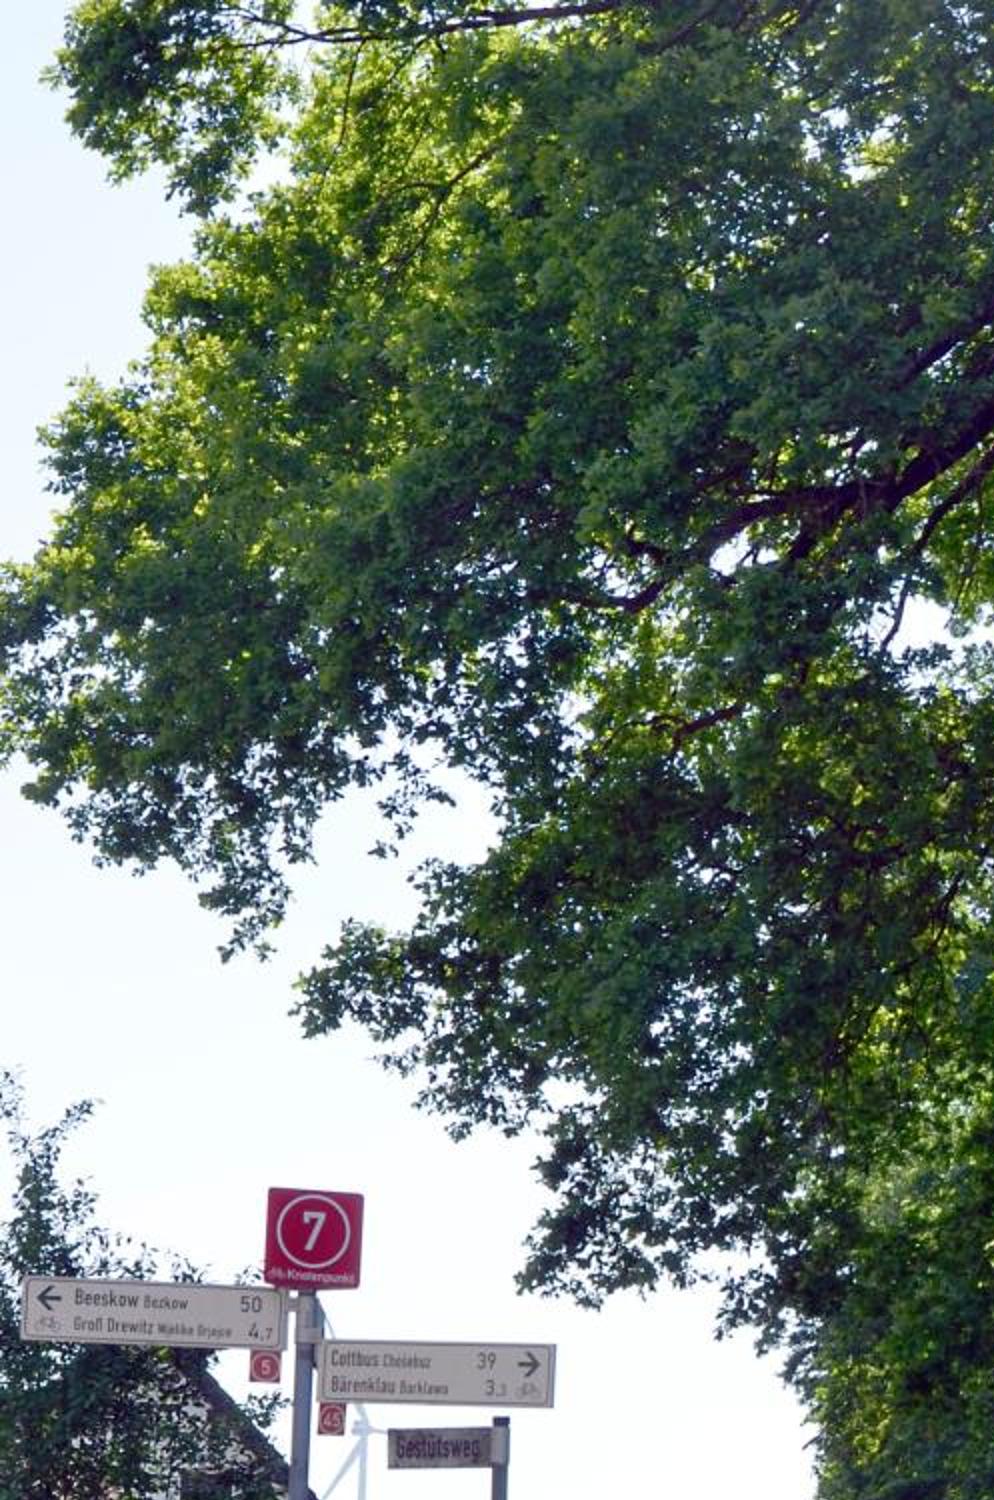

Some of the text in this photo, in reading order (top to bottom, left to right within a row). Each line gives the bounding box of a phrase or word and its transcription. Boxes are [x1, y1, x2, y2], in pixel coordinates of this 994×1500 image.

[303, 1210, 326, 1251] 7
[75, 1288, 139, 1309] Beeskow
[240, 1295, 263, 1313] 50
[107, 1318, 154, 1335] Drewitz
[261, 1359, 272, 1375] 5
[331, 1350, 379, 1368] Cottbus
[477, 1352, 497, 1370] 39
[331, 1375, 395, 1395] Bärenklau
[396, 1436, 480, 1463] Gestütsweg
